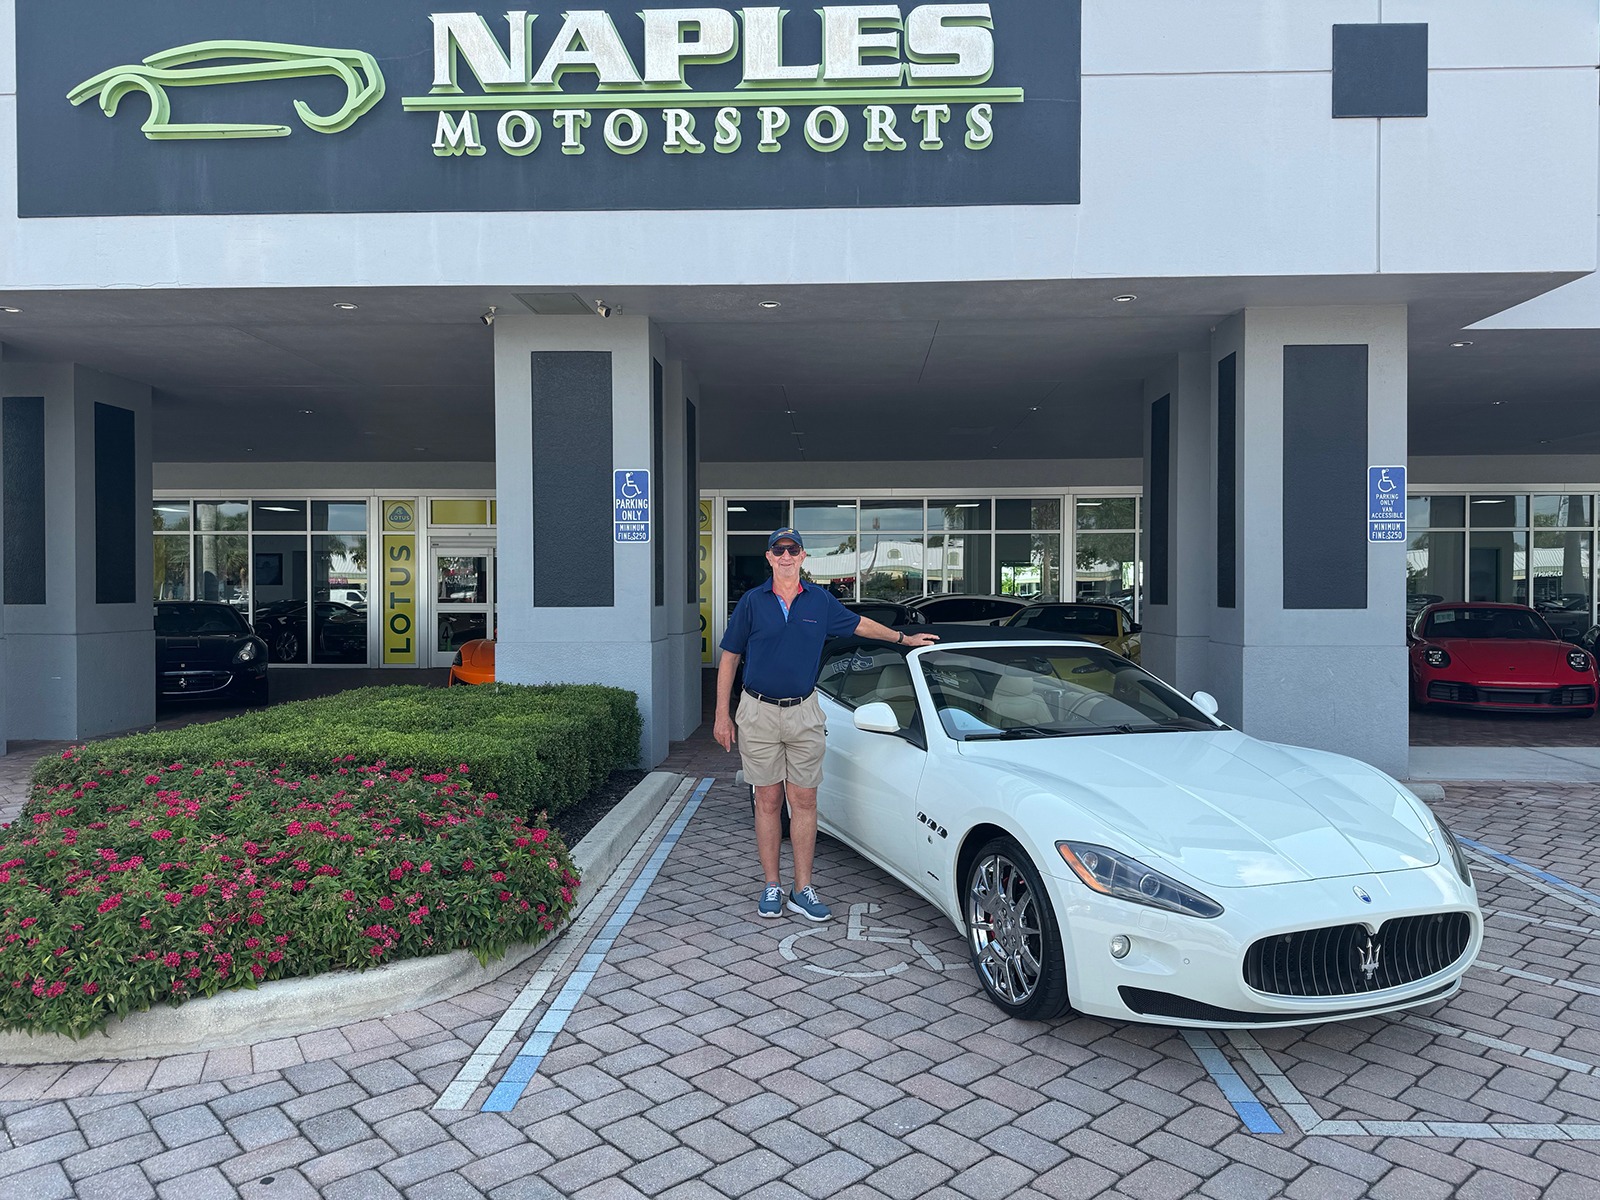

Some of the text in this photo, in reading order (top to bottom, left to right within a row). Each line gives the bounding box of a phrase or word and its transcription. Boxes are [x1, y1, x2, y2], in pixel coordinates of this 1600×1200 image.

[428, 3, 994, 94] NAPLES
[432, 104, 993, 156] MOTORSPORTS
[616, 499, 648, 509] PARKING
[621, 510, 642, 521] ONLY
[618, 532, 647, 540] FINE $250
[1372, 531, 1402, 539] FINE $250
[390, 545, 411, 653] LOTUS
